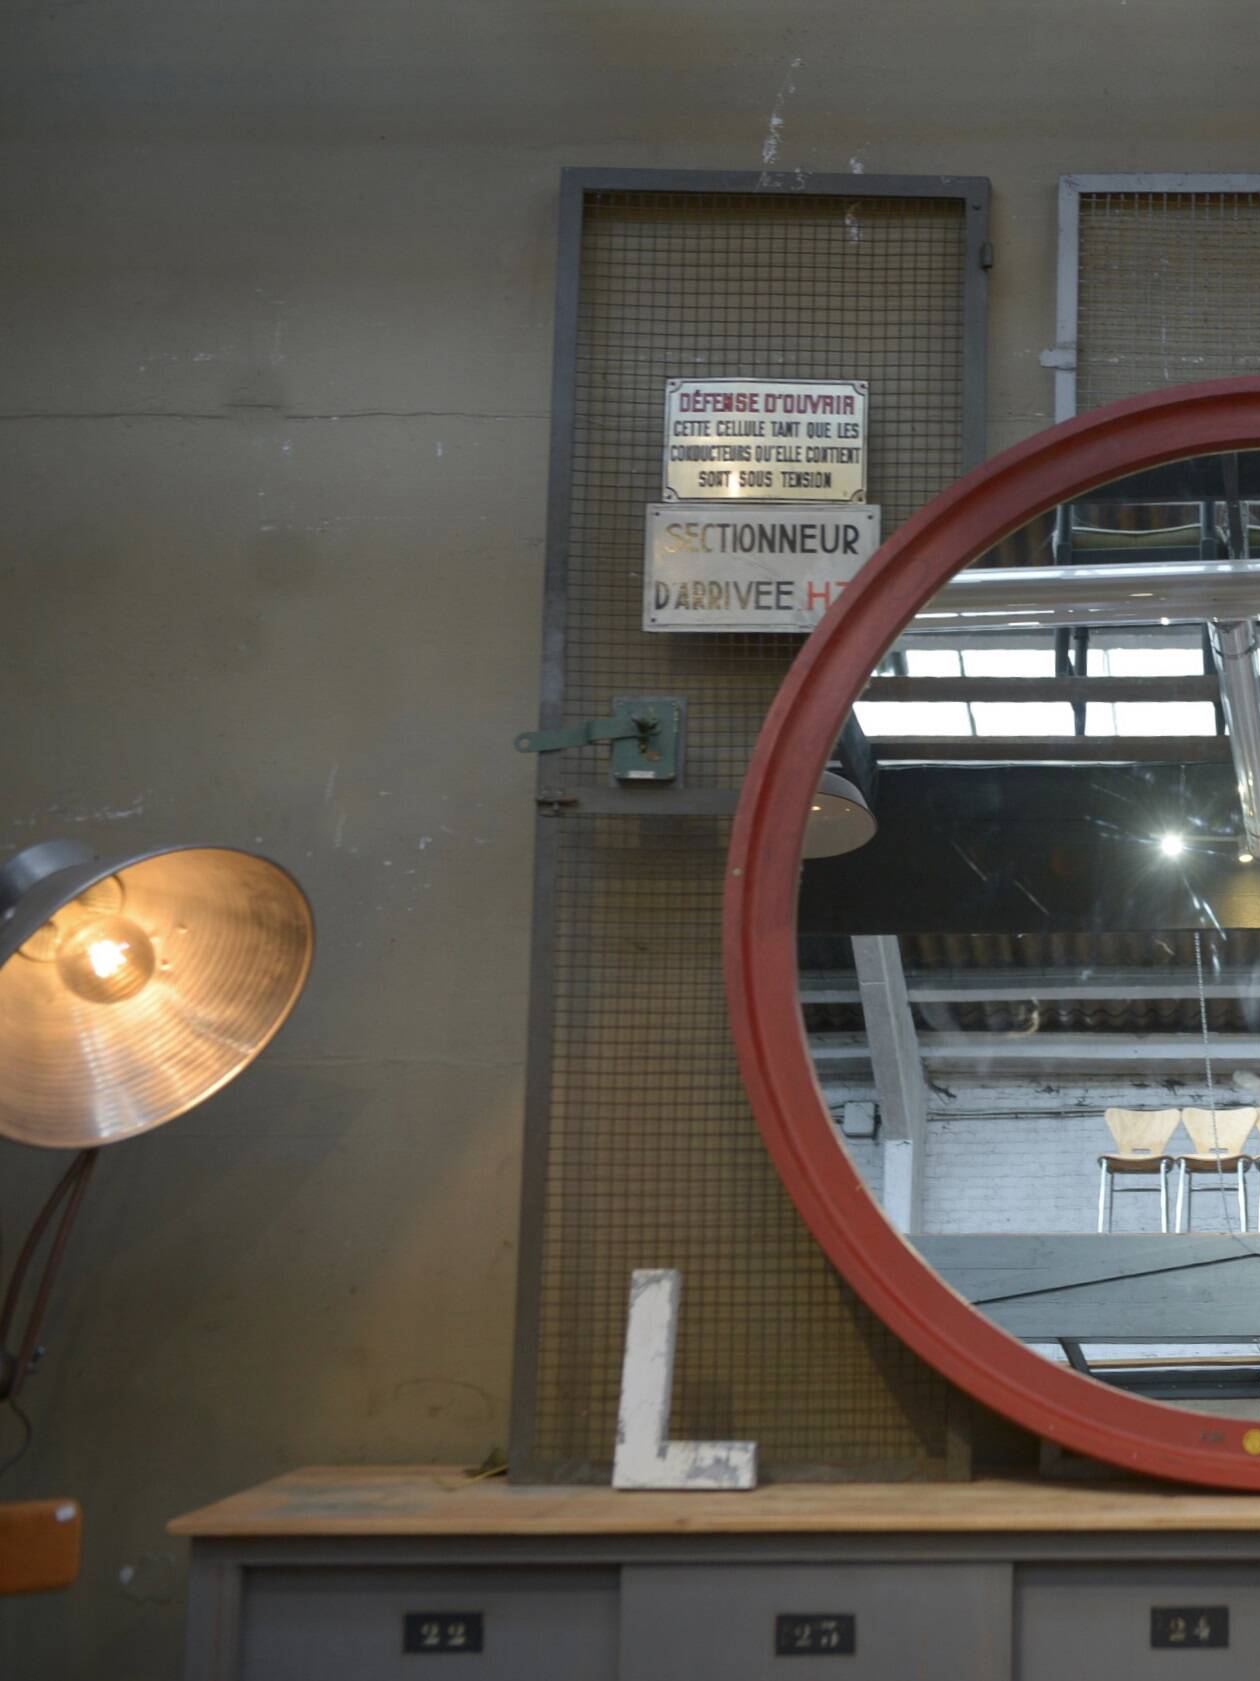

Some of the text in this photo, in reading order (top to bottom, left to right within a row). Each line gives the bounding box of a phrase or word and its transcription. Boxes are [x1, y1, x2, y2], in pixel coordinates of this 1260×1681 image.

[679, 390, 855, 415] DÉFENSE D'OUVRIR
[673, 420, 860, 439] CETTE CELLULE TANT QUE LES
[670, 445, 862, 464] CONDUCTEURS QU'ELLE CONTIENT
[699, 471, 832, 488] SONT SOUS TENSION
[666, 523, 860, 554] SECTIONNEUR
[655, 581, 794, 611] D'ARRIVEE
[612, 1269, 757, 1490] L
[420, 1622, 466, 1648] 22
[1167, 1616, 1211, 1643] 24
